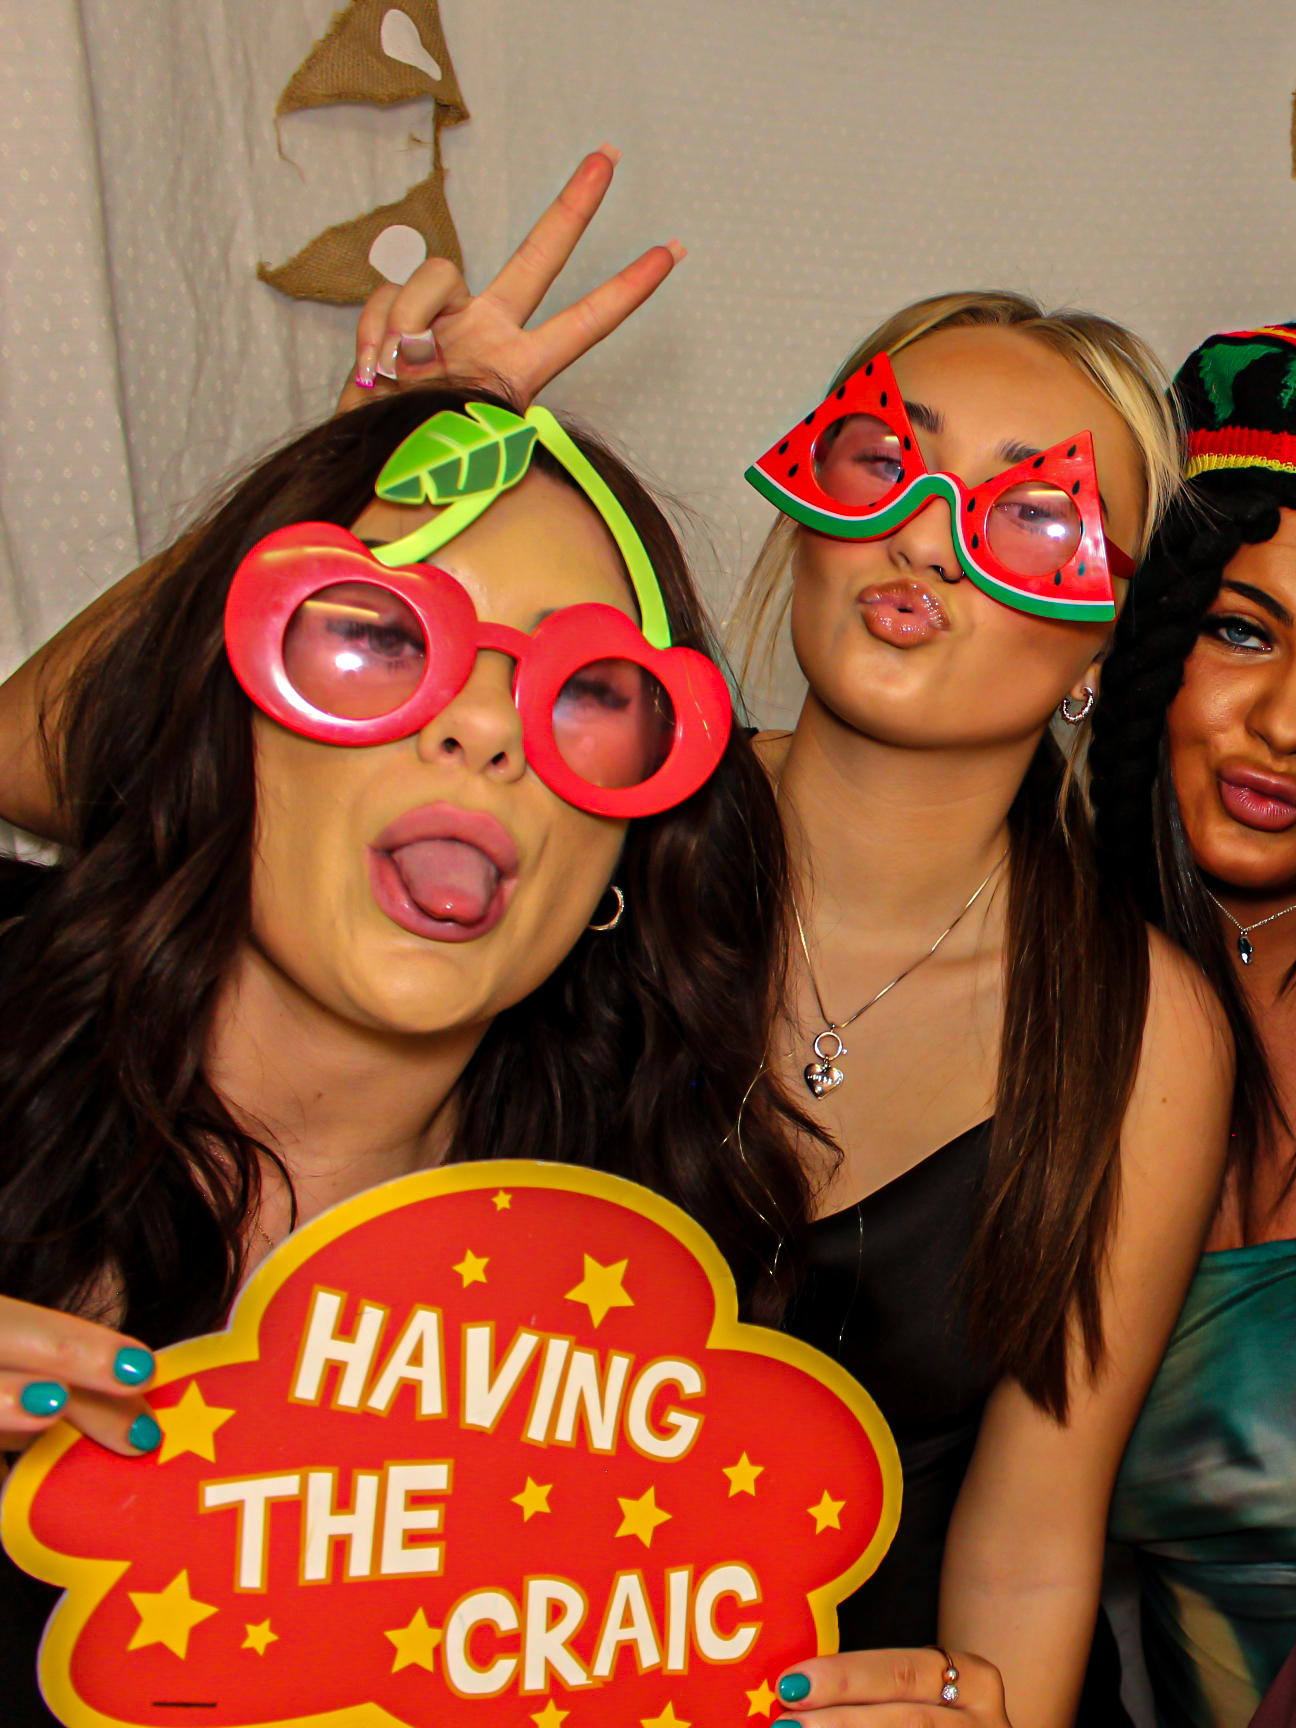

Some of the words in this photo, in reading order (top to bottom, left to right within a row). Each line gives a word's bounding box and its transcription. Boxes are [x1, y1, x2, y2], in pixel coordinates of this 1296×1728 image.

[294, 1290, 702, 1459] HAVING
[202, 1463, 450, 1590] THE
[444, 1564, 759, 1695] CRAIC
